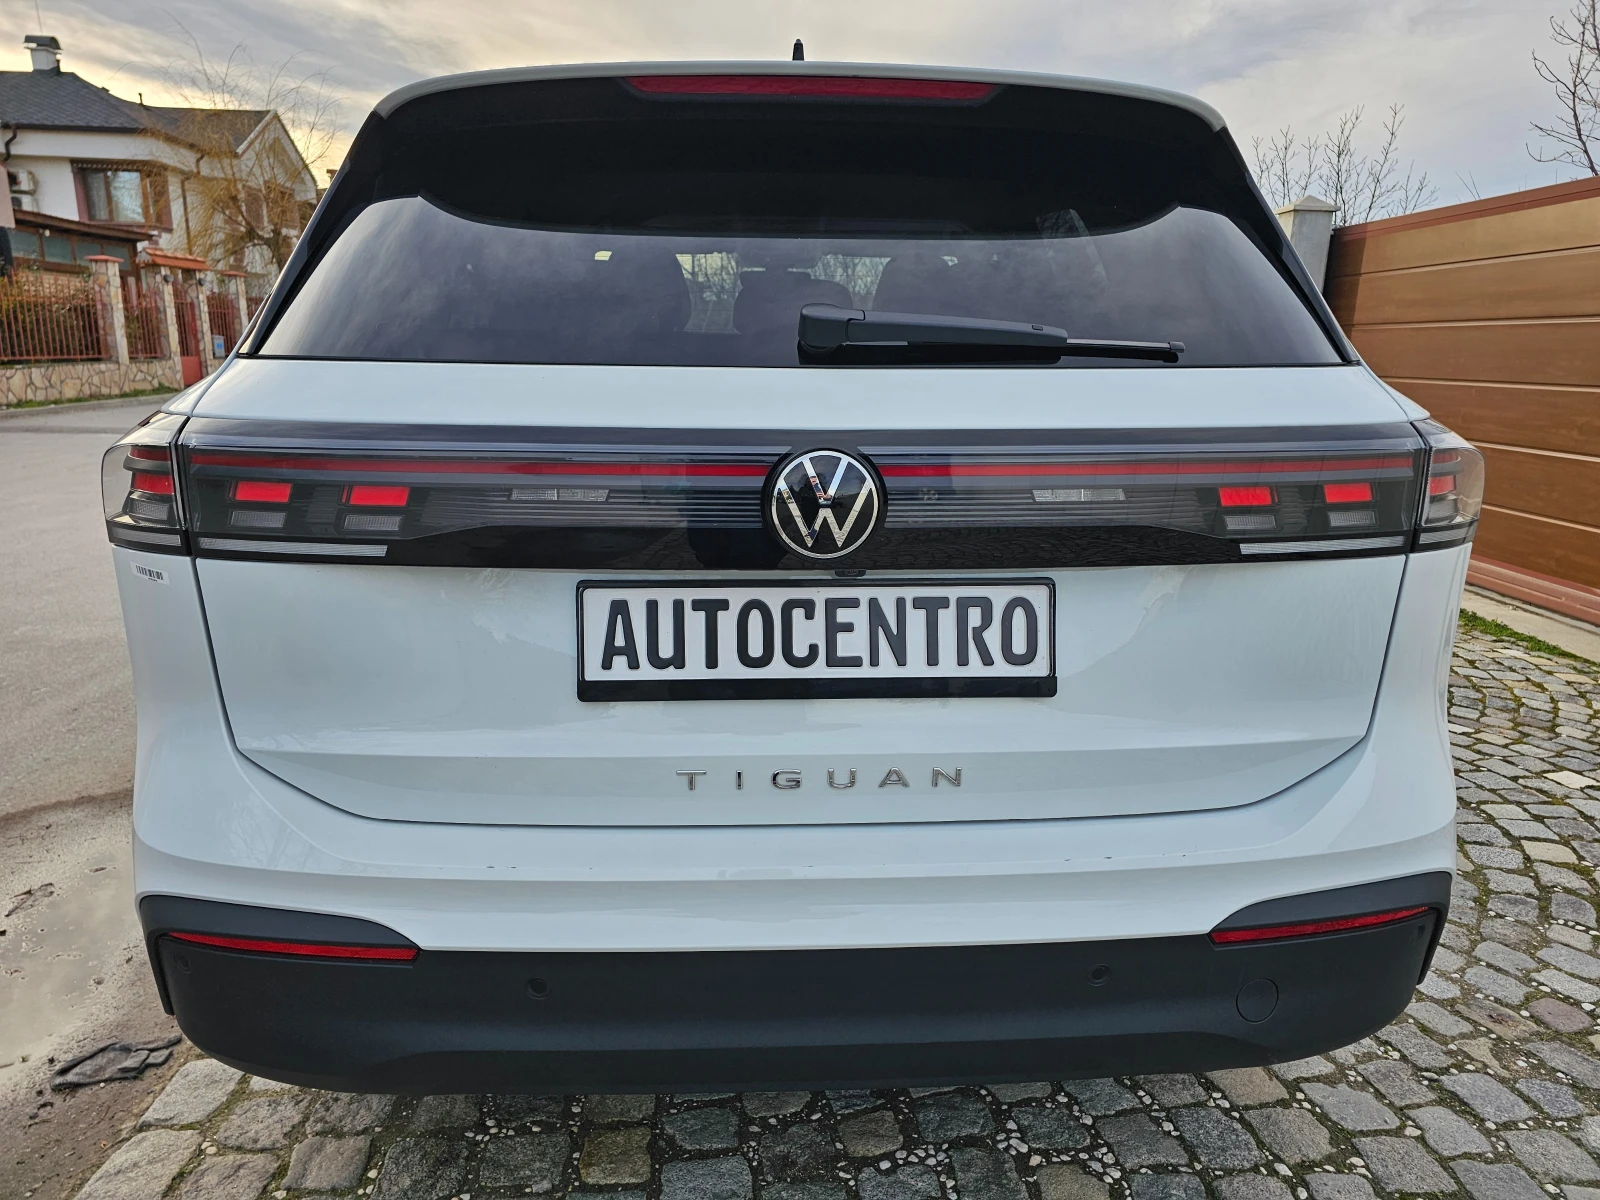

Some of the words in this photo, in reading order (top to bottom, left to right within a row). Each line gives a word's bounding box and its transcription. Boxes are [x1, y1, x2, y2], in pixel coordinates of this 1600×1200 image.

[776, 453, 875, 551] VW
[601, 596, 1038, 670] AUTOCENTRO
[676, 766, 962, 790] TIGUAN
